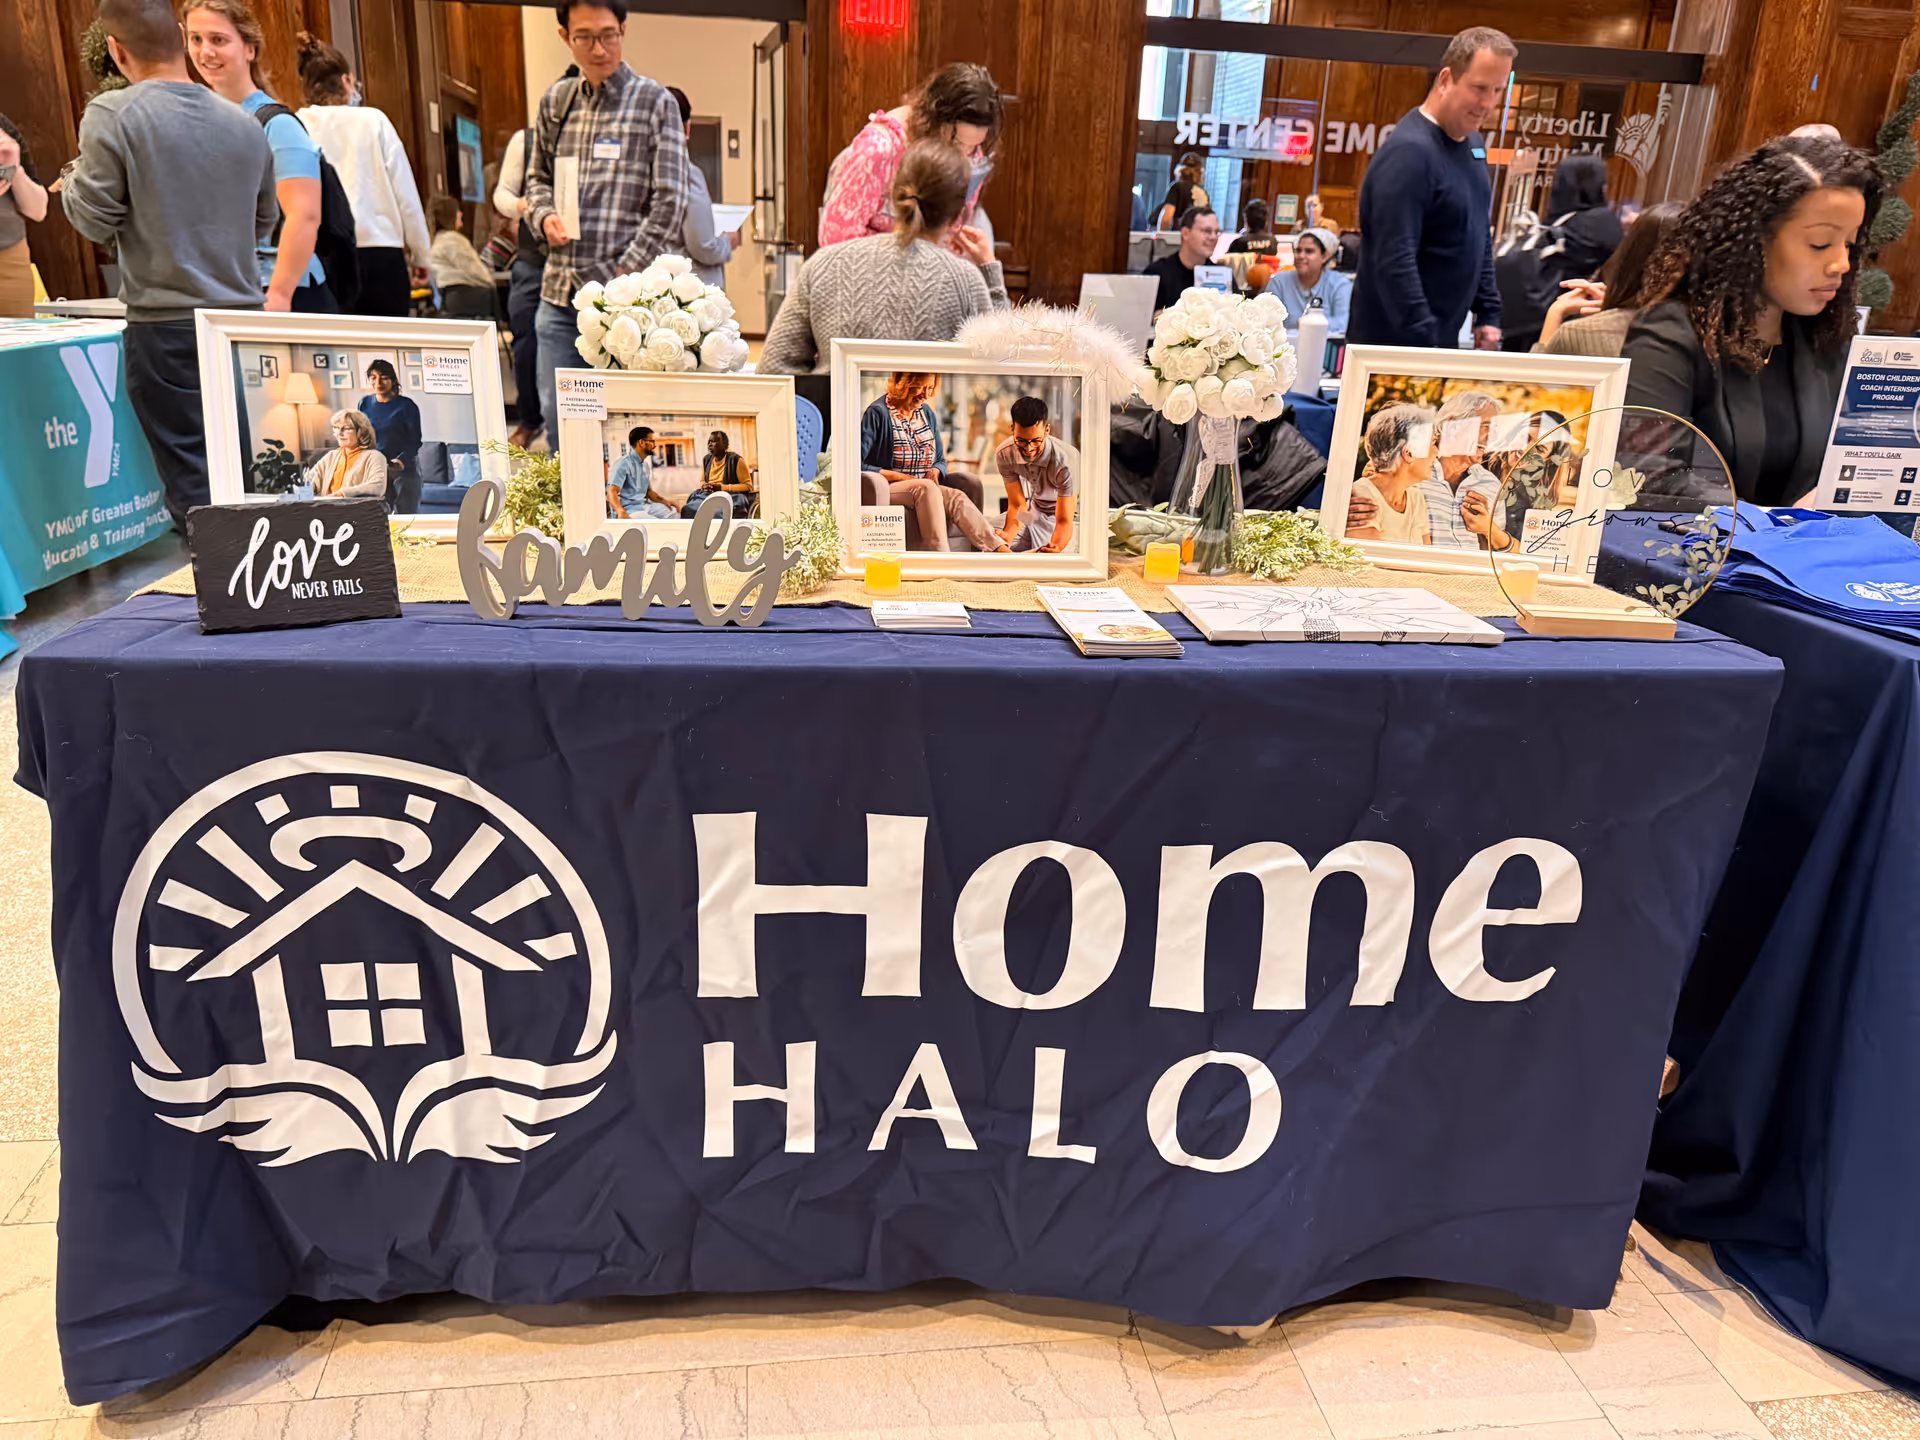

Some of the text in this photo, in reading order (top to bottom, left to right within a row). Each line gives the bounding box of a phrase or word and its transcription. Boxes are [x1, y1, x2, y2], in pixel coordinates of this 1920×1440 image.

[1247, 240, 1271, 250] STAFF
[440, 356, 468, 365] Home
[574, 380, 604, 388] Home
[1856, 373, 1885, 381] BOSTON
[44, 342, 119, 488] the Y
[875, 515, 903, 523] Home
[90, 534, 99, 549] &
[457, 477, 801, 627] family
[228, 517, 360, 609] love
[292, 578, 363, 600] NEVER FAILS
[693, 812, 1583, 1010] Home
[703, 1041, 1282, 1173] HALO
